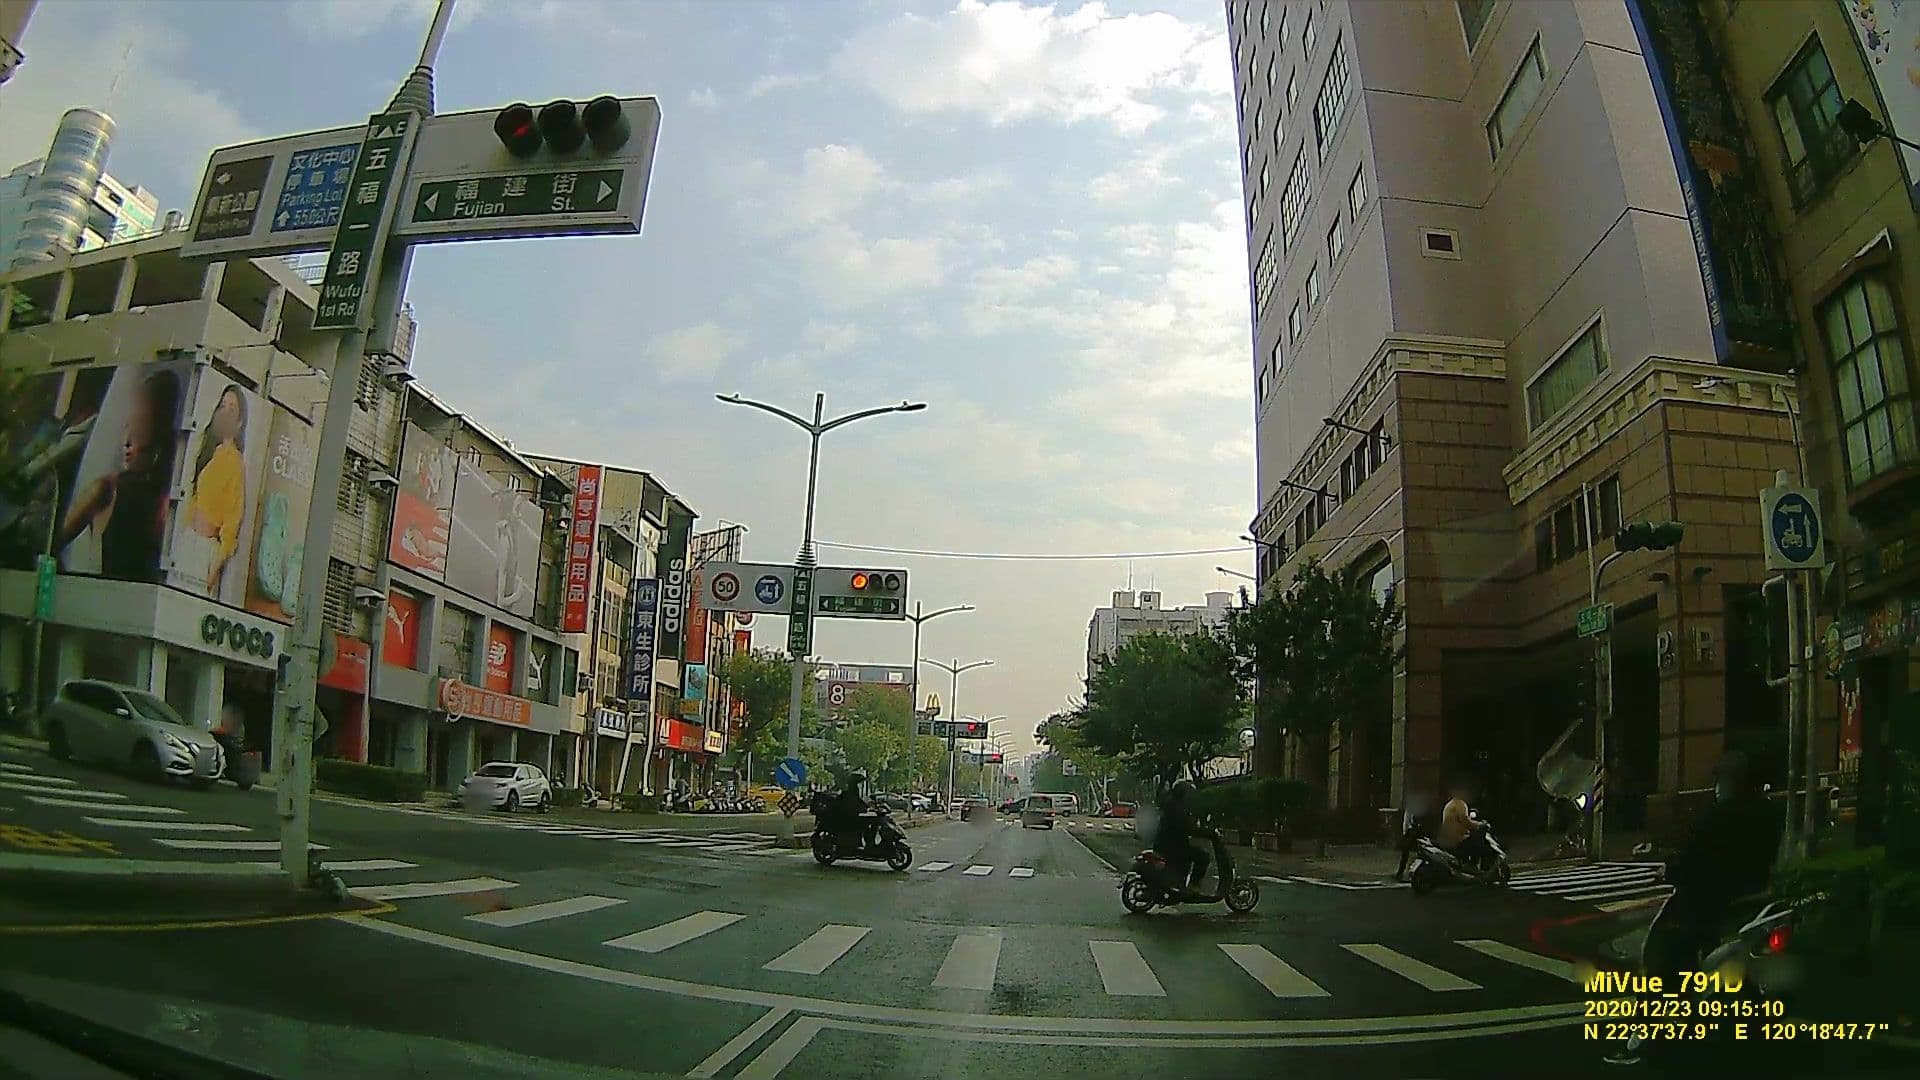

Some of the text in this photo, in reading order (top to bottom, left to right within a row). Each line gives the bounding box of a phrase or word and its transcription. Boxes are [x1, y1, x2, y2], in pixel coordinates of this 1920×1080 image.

[293, 149, 354, 170] 文化中心
[455, 173, 578, 201] 福建街
[337, 148, 390, 276] 五福一路
[453, 196, 575, 219] Fujian St.
[326, 284, 361, 298] Wufu
[663, 558, 684, 633] adidas
[718, 581, 734, 593] 50
[201, 614, 275, 659] crocs
[632, 611, 655, 694] 東生診所
[830, 684, 845, 705] 8
